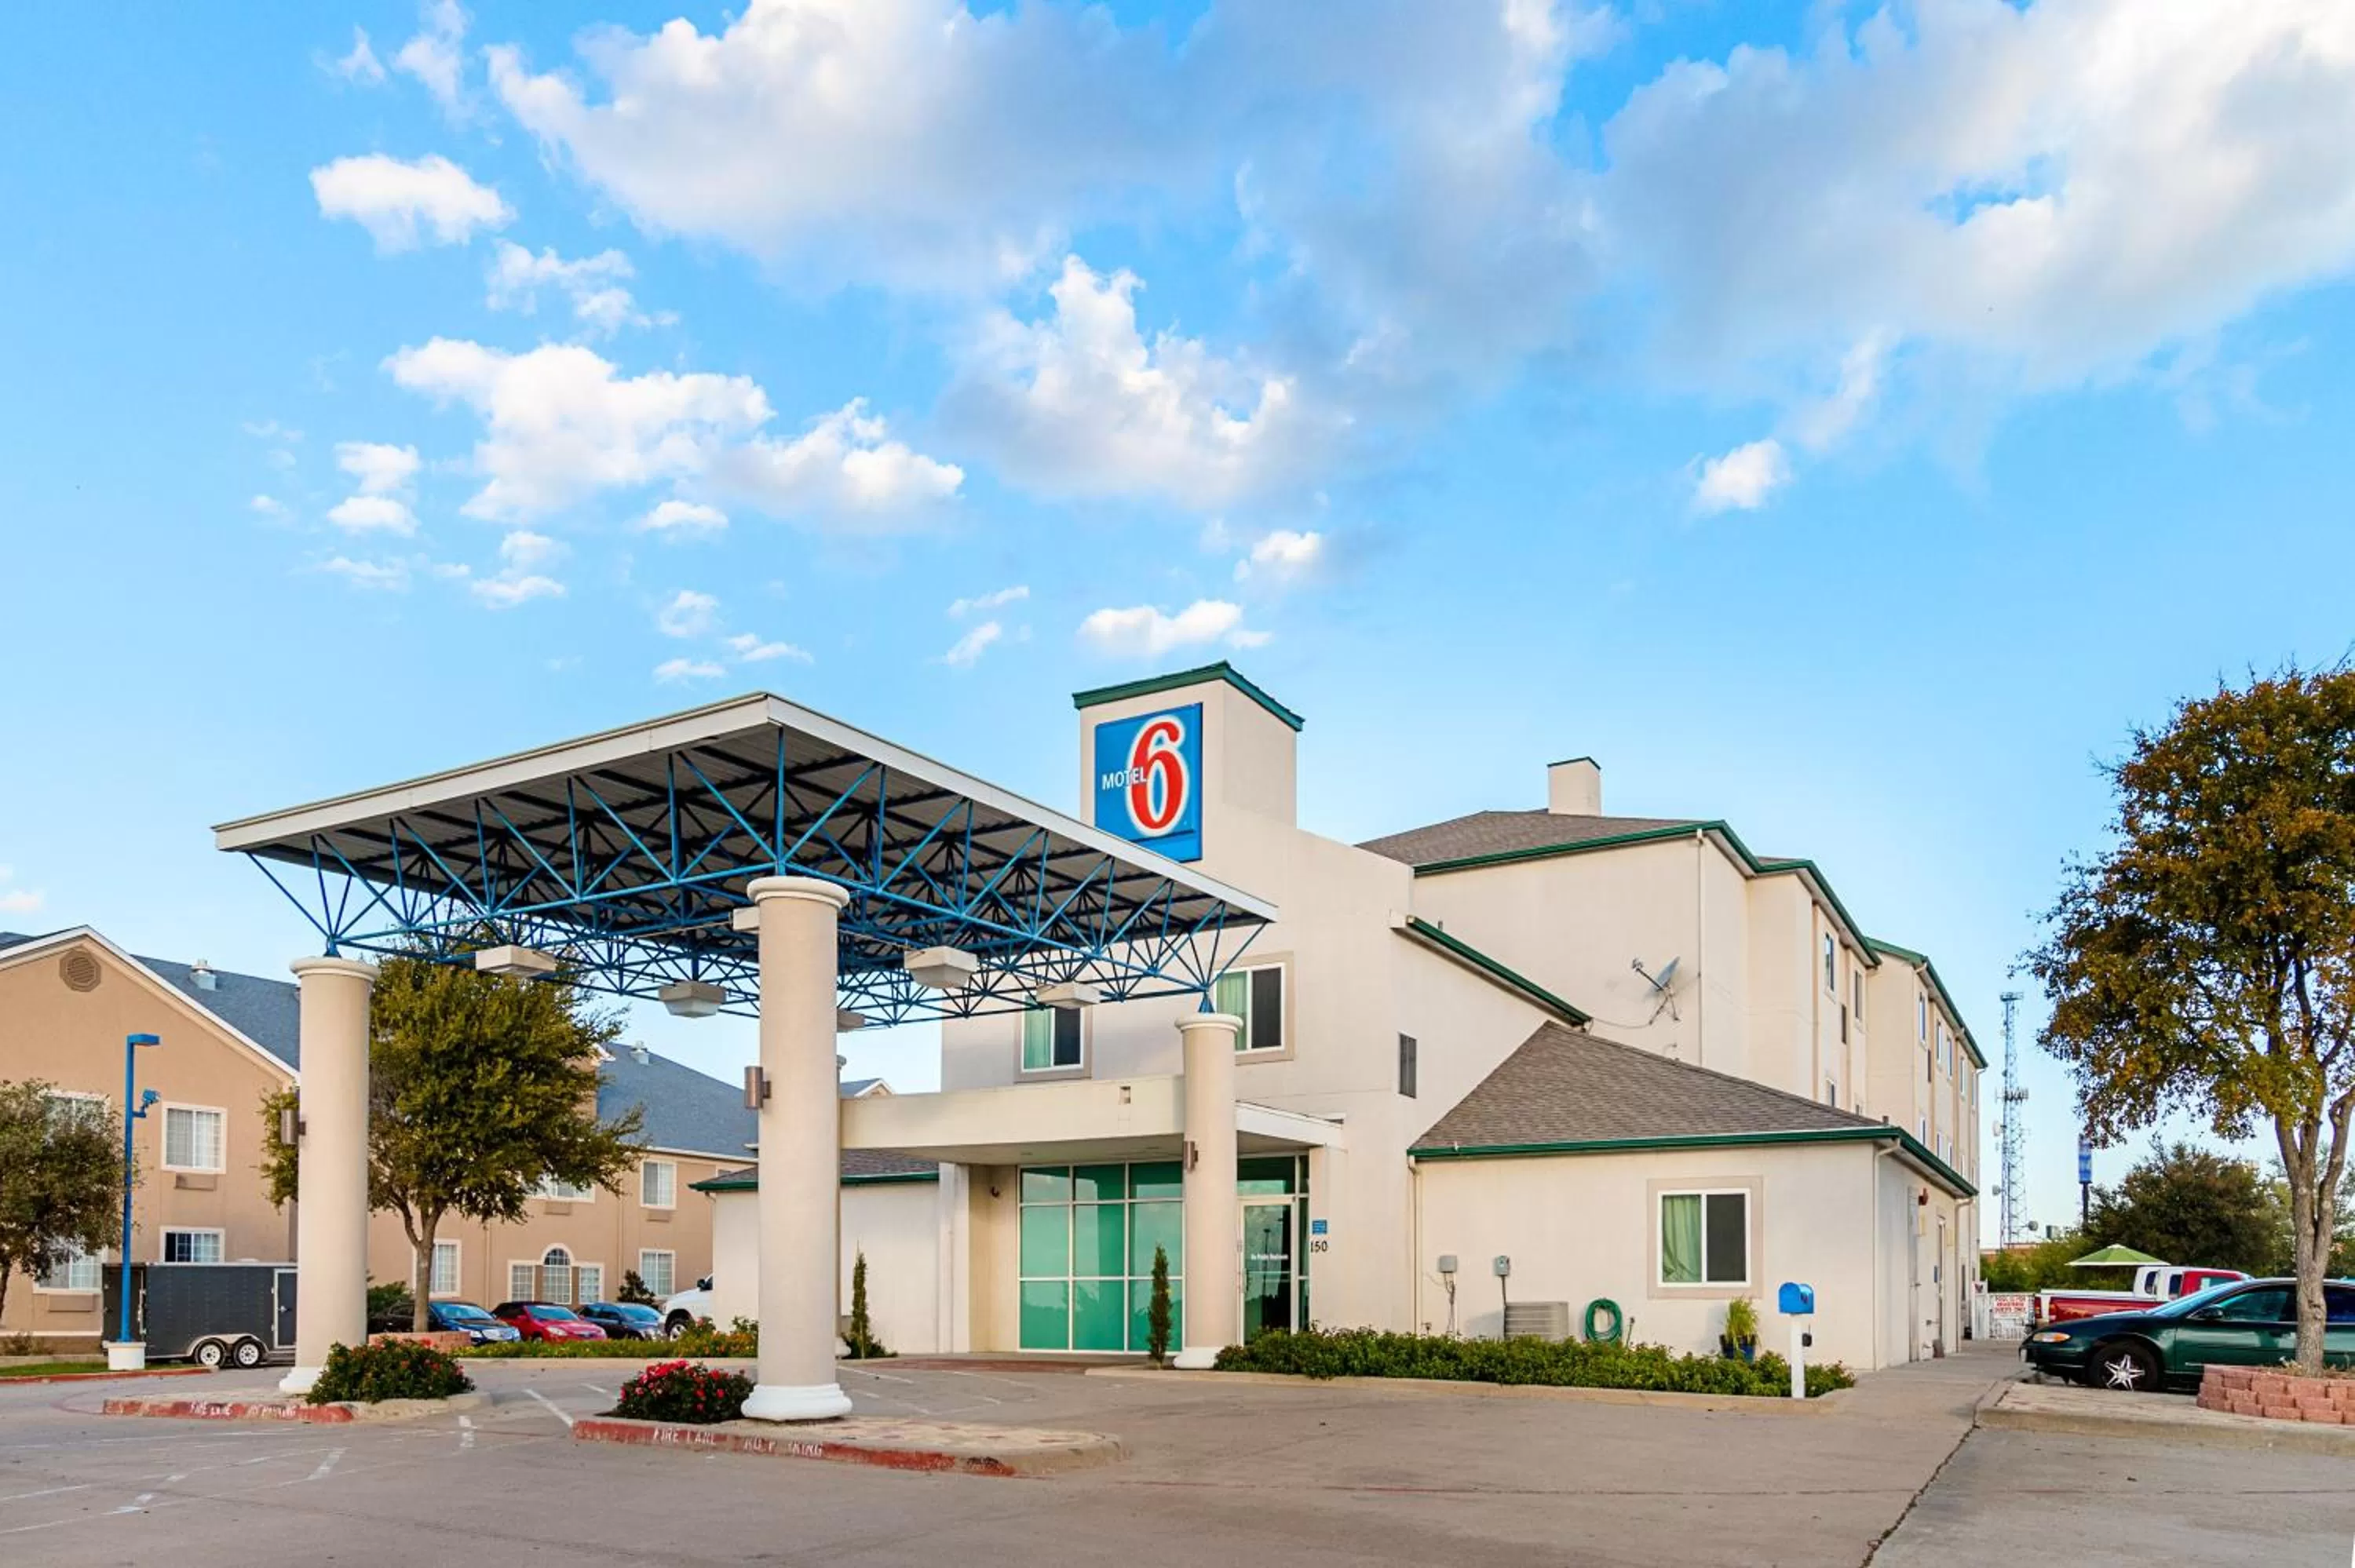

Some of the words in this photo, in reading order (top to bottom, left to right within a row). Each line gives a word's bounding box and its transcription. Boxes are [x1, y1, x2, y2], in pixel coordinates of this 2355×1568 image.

[1101, 766, 1148, 790] MOTEL
[1126, 716, 1188, 835] 6
[1310, 1240, 1328, 1253] 150
[652, 1426, 680, 1444] FIRE
